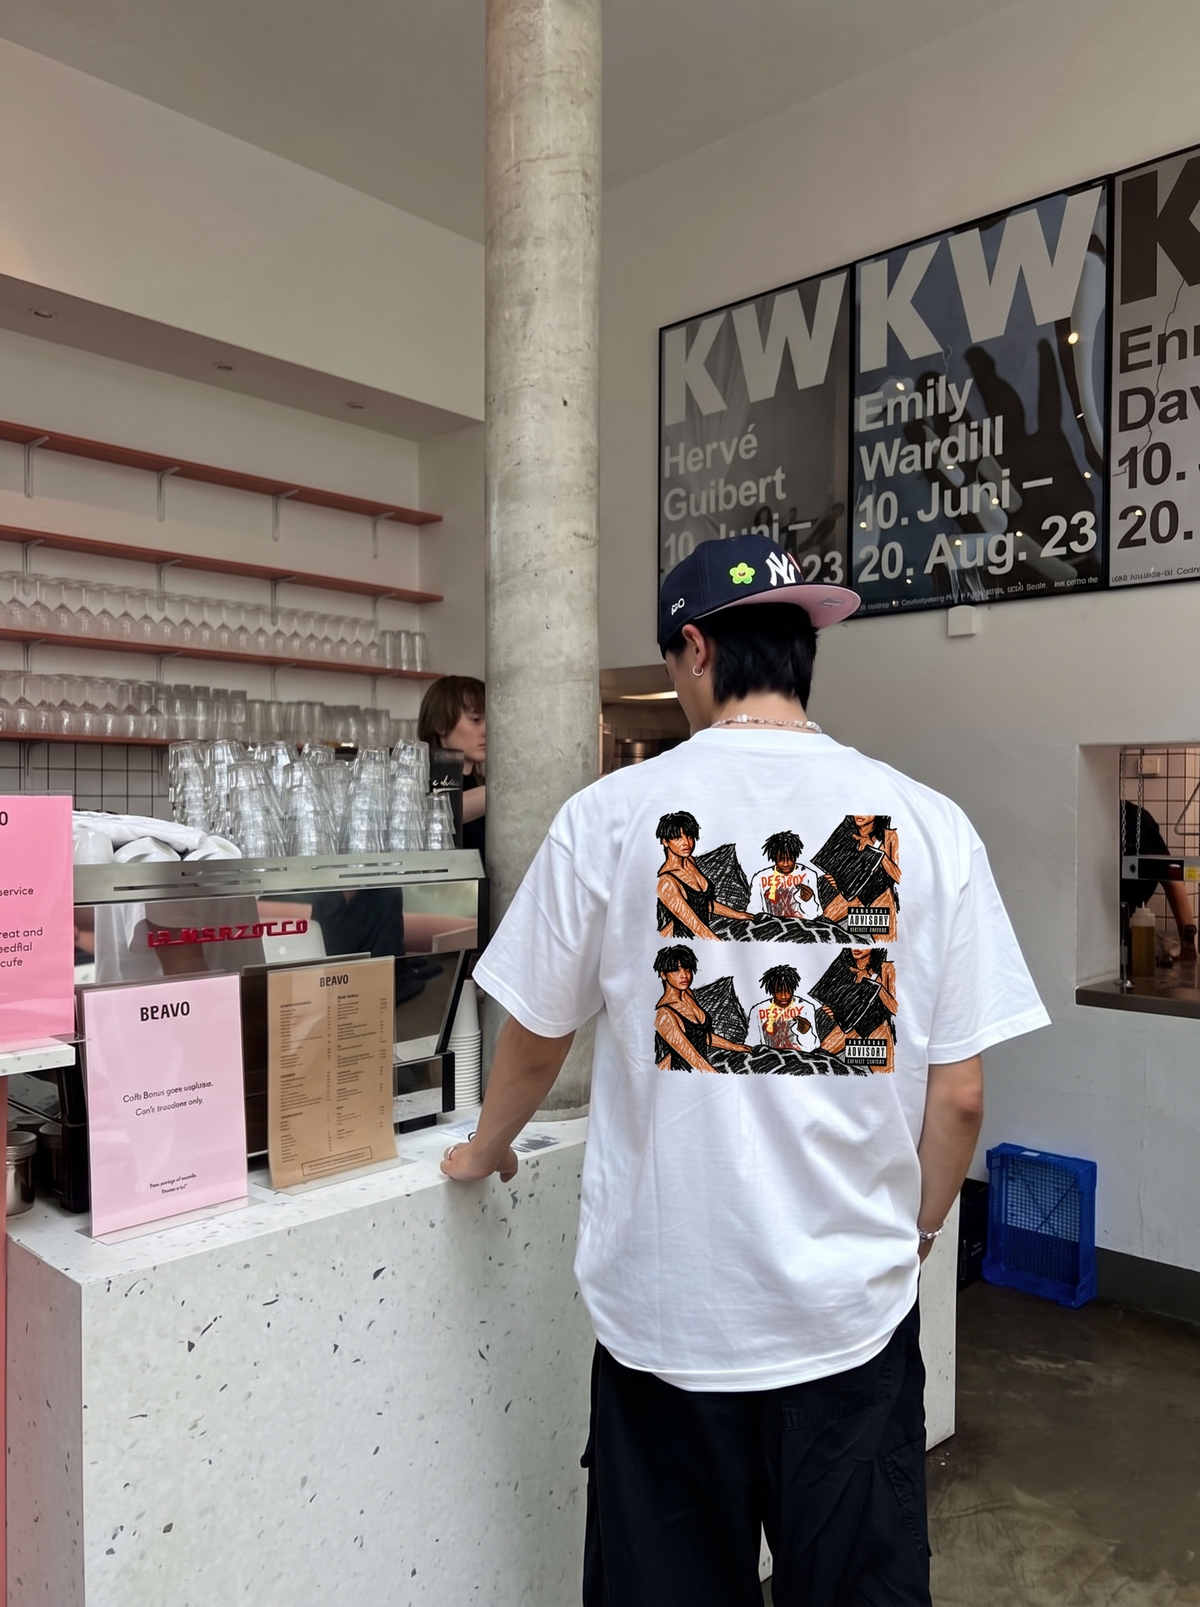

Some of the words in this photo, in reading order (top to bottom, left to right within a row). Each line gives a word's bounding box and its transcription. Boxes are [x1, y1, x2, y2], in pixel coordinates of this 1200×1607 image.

[860, 185, 1103, 373] KW
[664, 271, 848, 426] KW
[857, 375, 974, 433] Emily
[664, 424, 758, 479] Hervé
[859, 416, 1004, 481] Wardill
[1117, 442, 1187, 490] 10.
[663, 469, 787, 523] Guibert
[859, 493, 909, 531] 10.
[917, 467, 1011, 523] Juni
[858, 543, 913, 585] 20.
[923, 531, 1027, 575] Aug.
[1040, 510, 1097, 558] 23
[1117, 500, 1194, 550] 20.
[802, 550, 844, 585] 23
[23, 926, 43, 937] and
[850, 915, 888, 925] ADVISORY
[847, 1046, 885, 1057] ADVISORY
